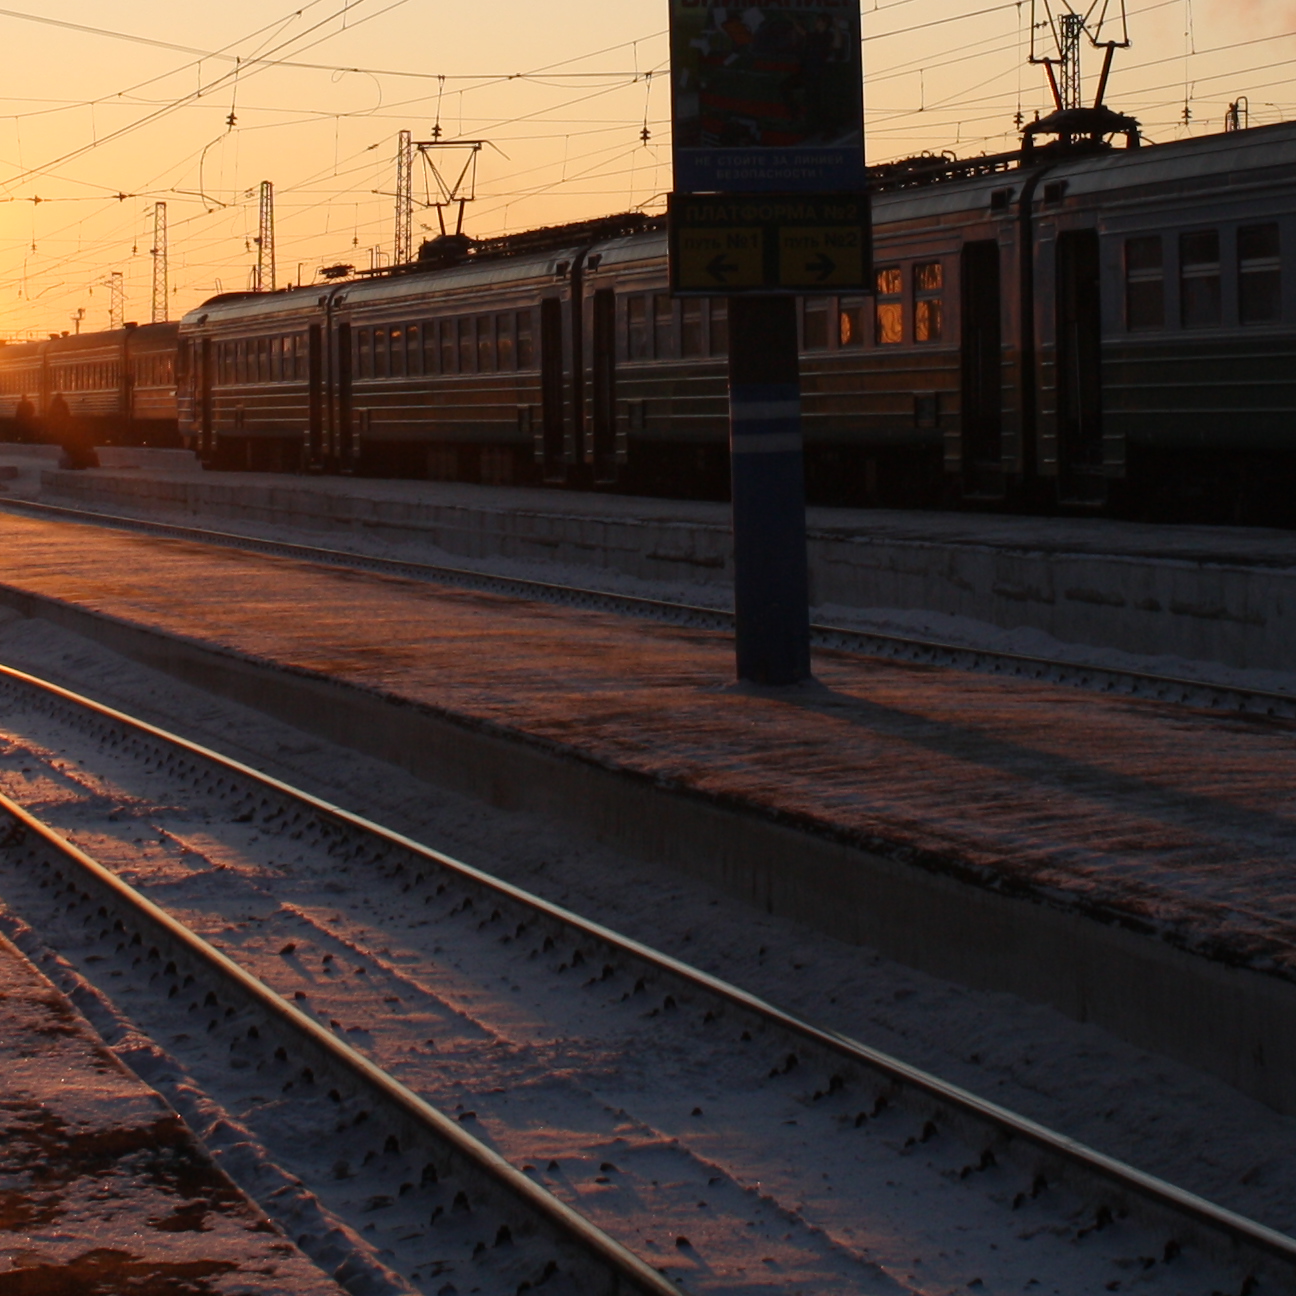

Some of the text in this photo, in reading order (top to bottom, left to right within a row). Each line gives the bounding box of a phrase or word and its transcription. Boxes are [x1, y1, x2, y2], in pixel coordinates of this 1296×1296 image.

[695, 153, 844, 167] НЕ СТОЙТЕ ЗА ЛИНИЕЙ
[685, 204, 858, 222] ПЛАТФОРМА №2
[684, 233, 759, 251] путь №1
[784, 232, 858, 250] путь №2
